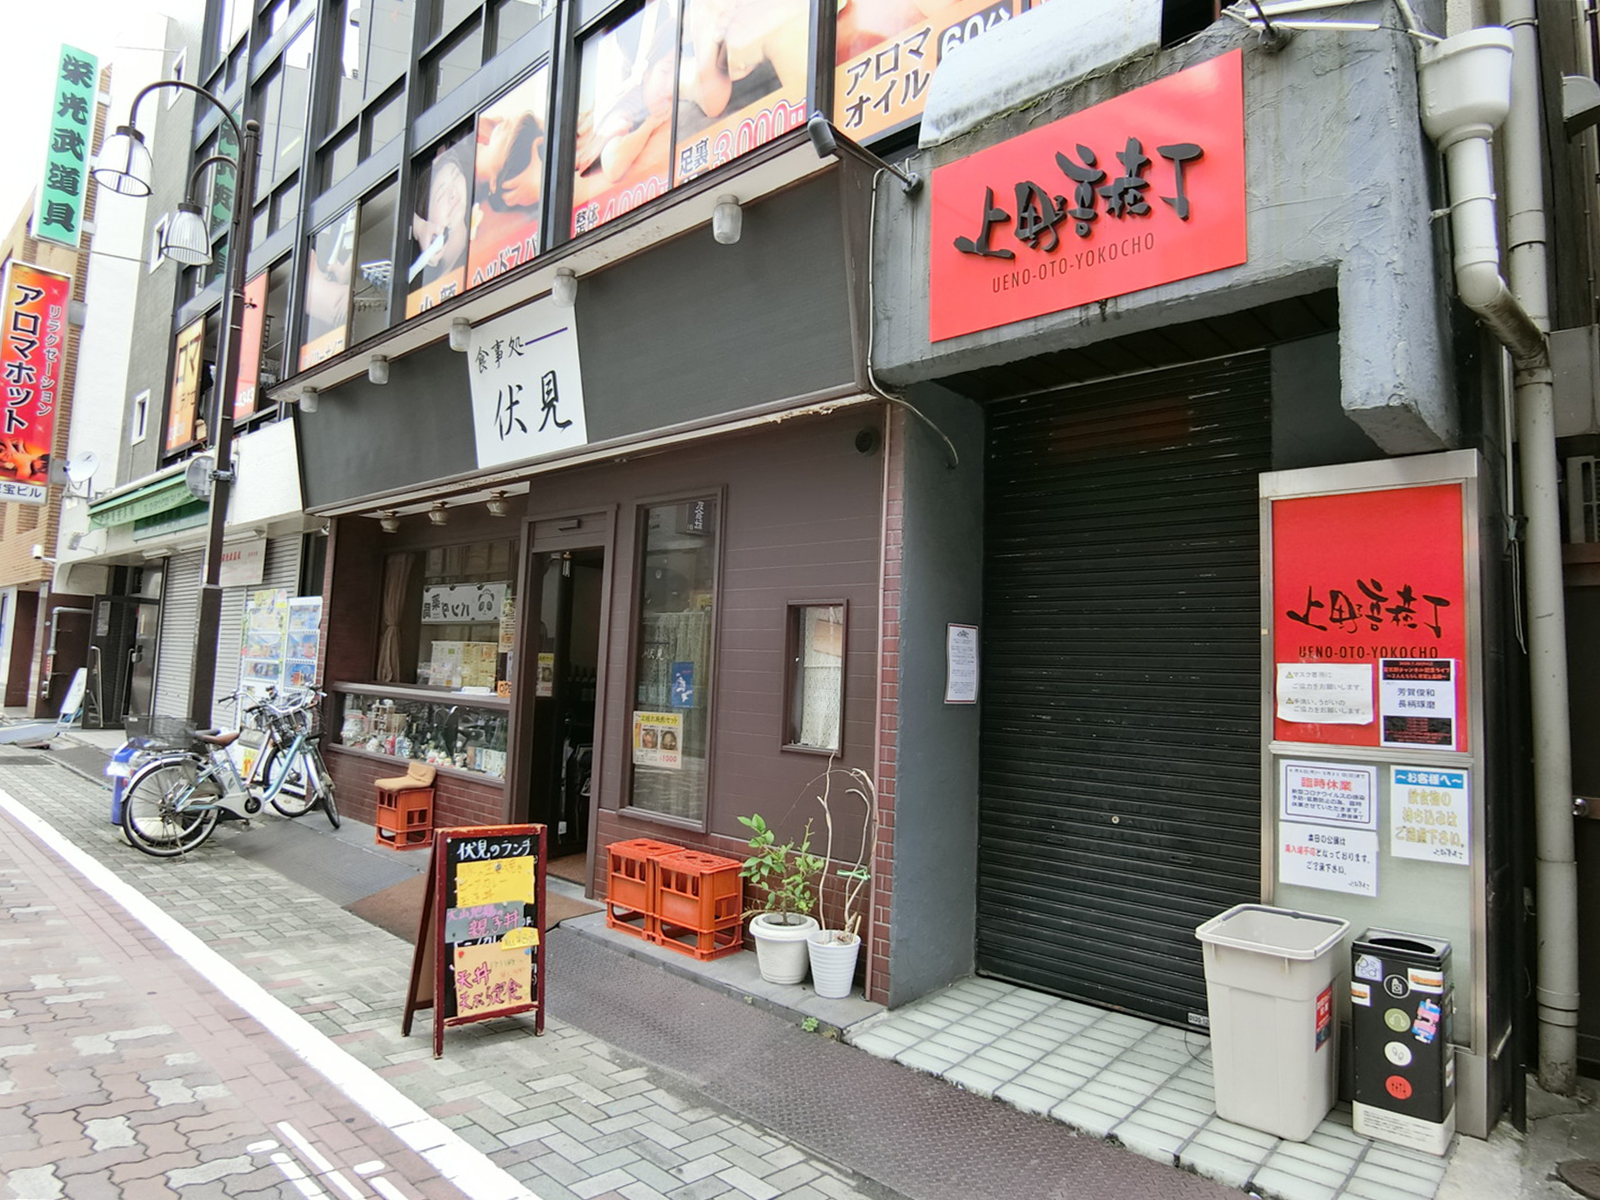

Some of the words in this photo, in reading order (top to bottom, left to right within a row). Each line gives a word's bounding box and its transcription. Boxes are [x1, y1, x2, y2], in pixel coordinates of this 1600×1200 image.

[845, 26, 932, 97] アロマ
[845, 69, 931, 128] オイル
[679, 139, 709, 178] 足裏
[992, 233, 1155, 293] UENO-OTO-YOKOCHO
[4, 284, 45, 434] アロマホット
[37, 305, 61, 416] リラクセーション
[475, 336, 524, 374] 食事処
[494, 370, 573, 441] 伏見
[0, 483, 42, 498] 宝ビル
[1298, 645, 1439, 659] UENO-OTO-YOKOCHO
[1301, 776, 1351, 791] 臨時休業
[457, 838, 531, 860] 伏見のランチ
[468, 909, 520, 937] 親子丼
[457, 962, 491, 992] 天丼
